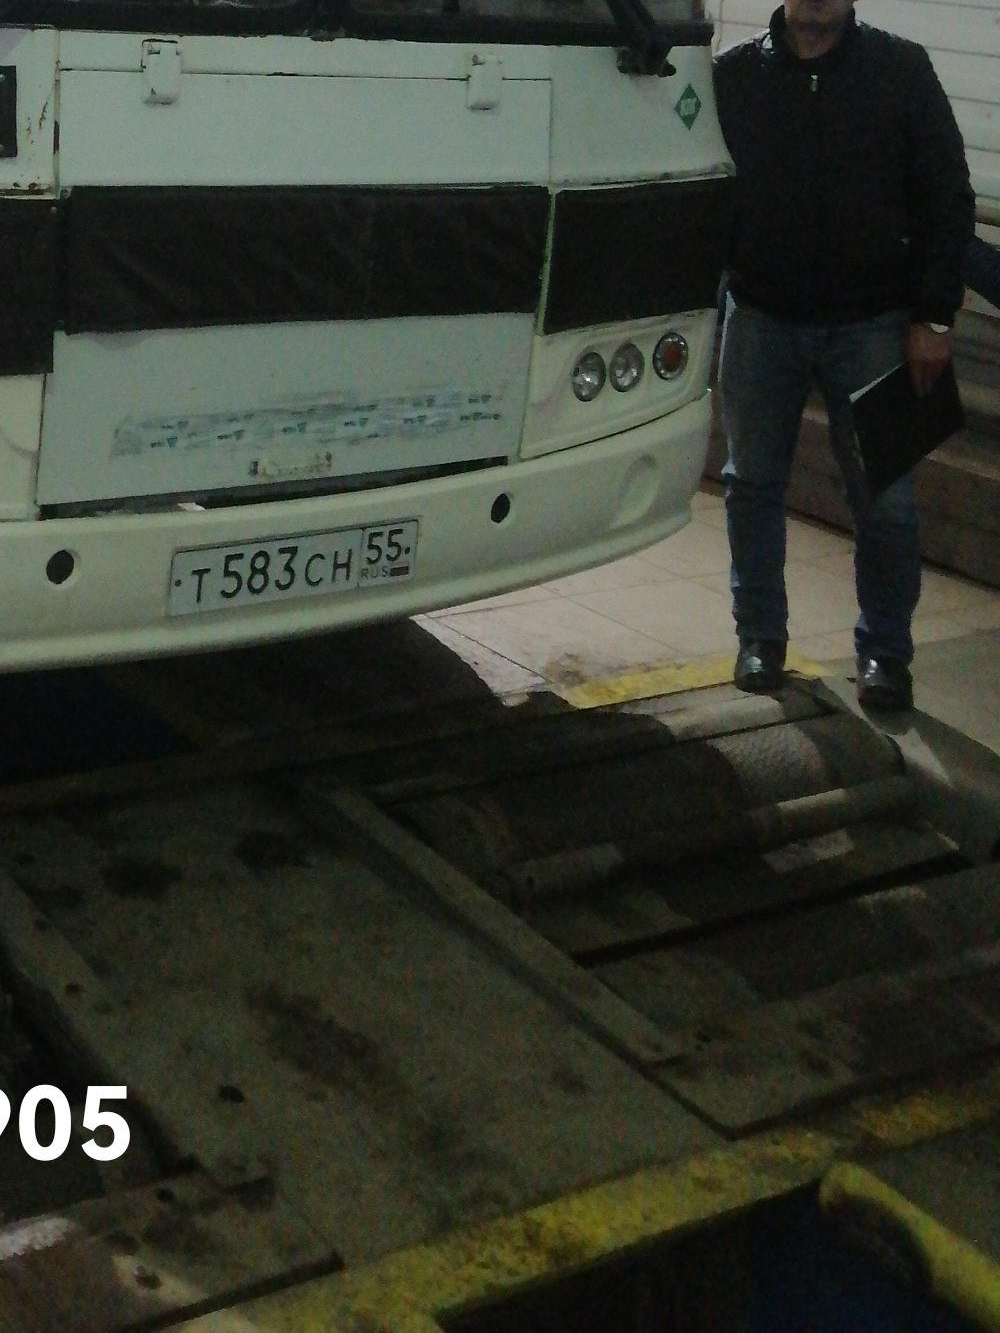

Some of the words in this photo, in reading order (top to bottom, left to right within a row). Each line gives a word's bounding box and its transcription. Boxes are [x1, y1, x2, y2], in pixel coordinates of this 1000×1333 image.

[191, 545, 352, 604] Т583СН
[366, 528, 404, 565] 55
[360, 567, 390, 579] RUS
